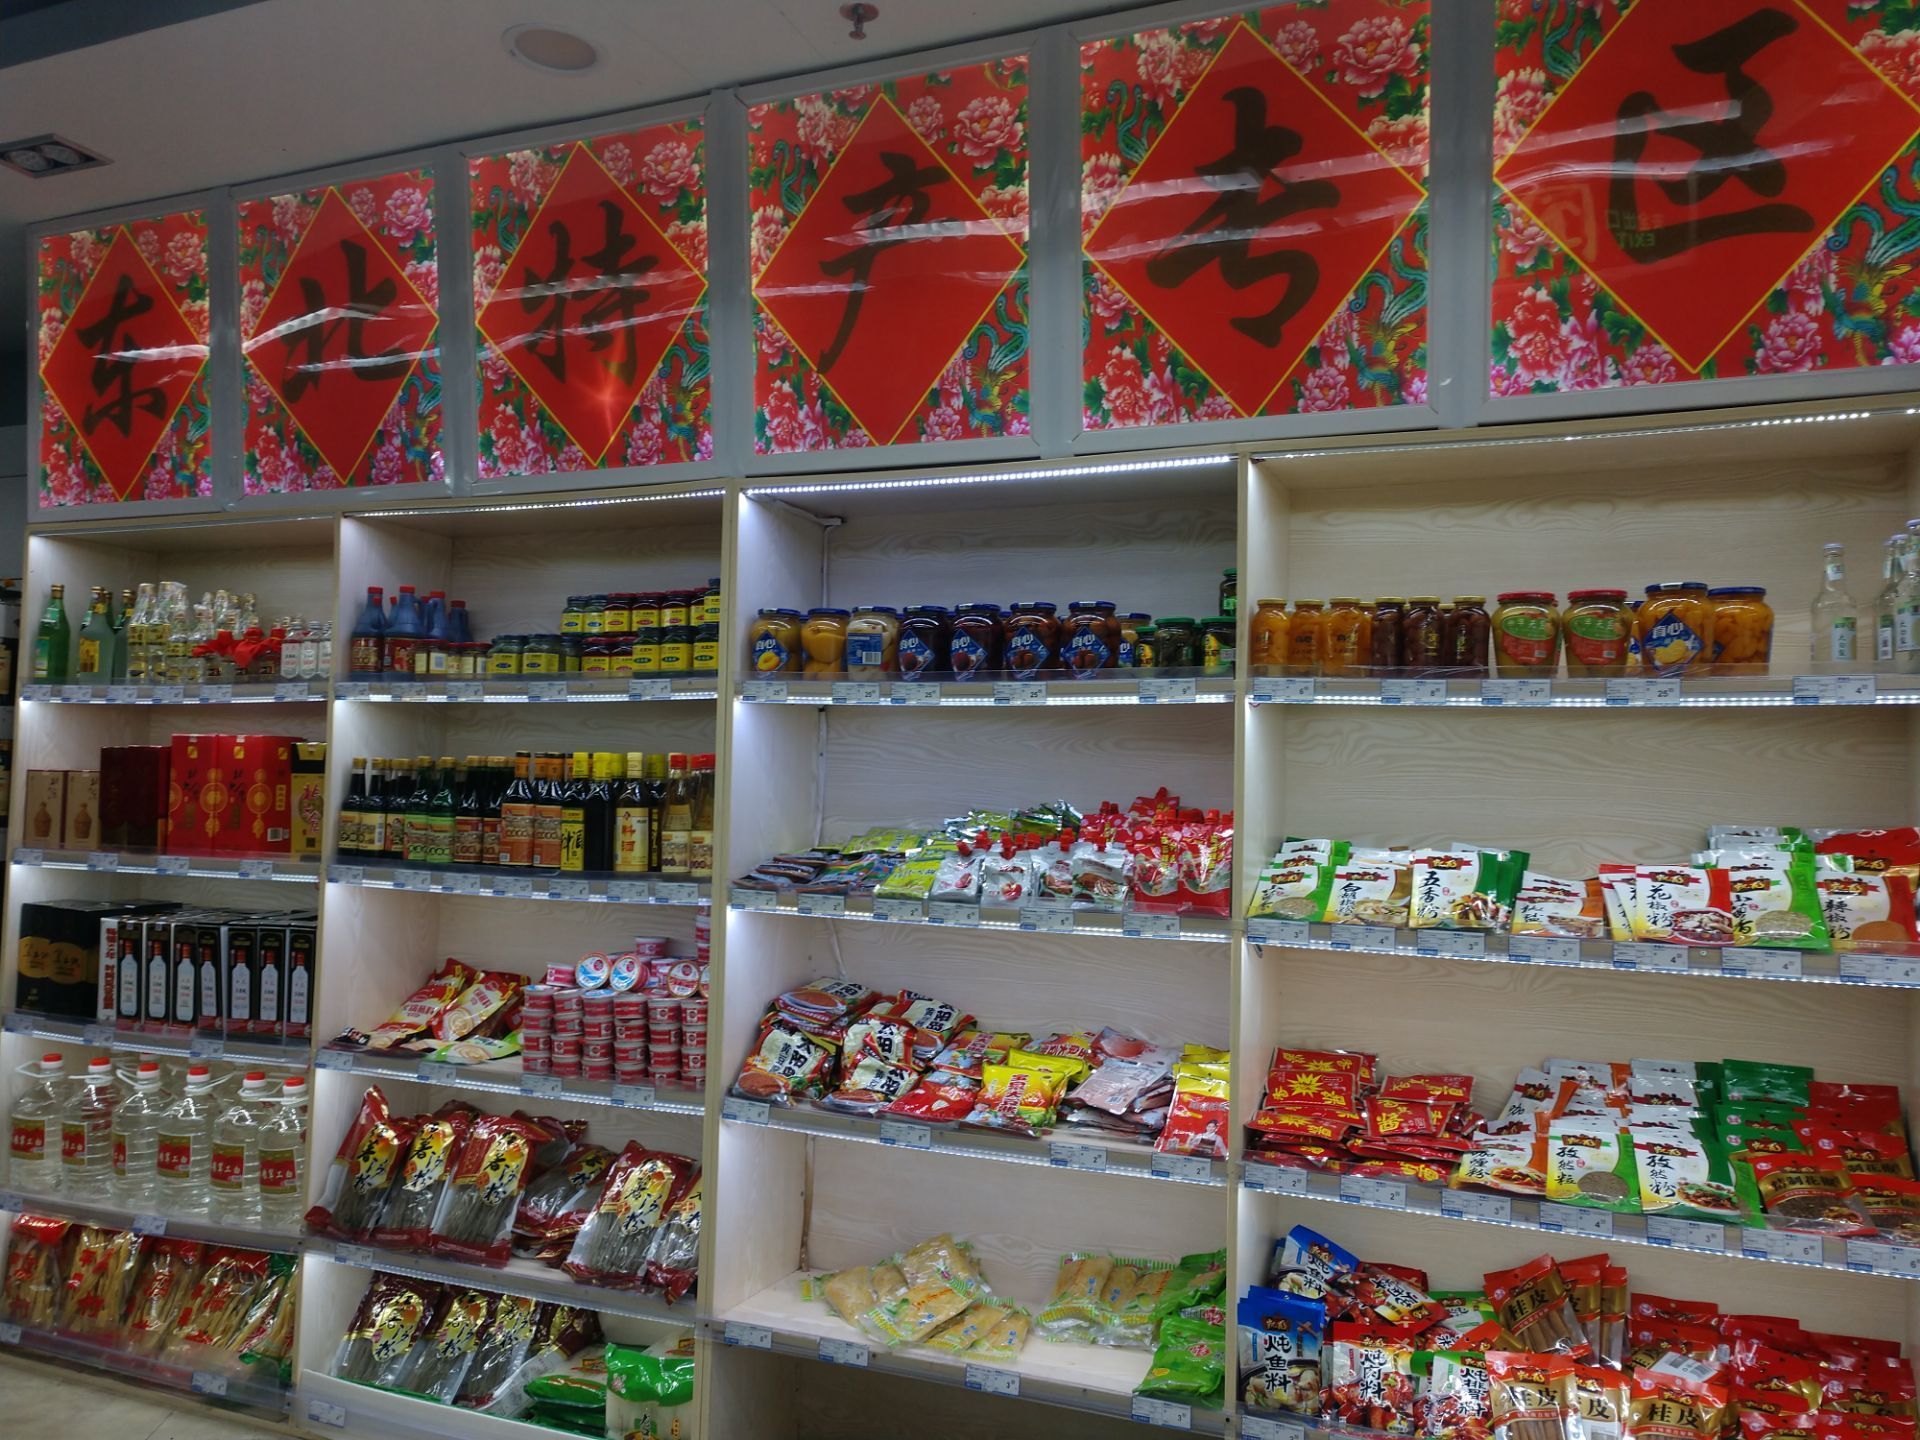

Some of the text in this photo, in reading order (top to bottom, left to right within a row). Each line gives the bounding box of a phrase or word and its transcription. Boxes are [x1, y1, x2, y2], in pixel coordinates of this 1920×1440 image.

[76, 7, 1816, 439] 东 北 特 产 专 区
[1416, 871, 1442, 920] 五香粉
[1646, 883, 1675, 929] 花椒粉
[1823, 898, 1853, 941] 辣椒粉
[1555, 1146, 1581, 1186] 孜然粒
[1646, 1155, 1678, 1198] 孜然粉
[1508, 1288, 1552, 1322] 桂皮
[1263, 1333, 1293, 1394] 炖鱼料
[1648, 1403, 1701, 1429] 桂皮
